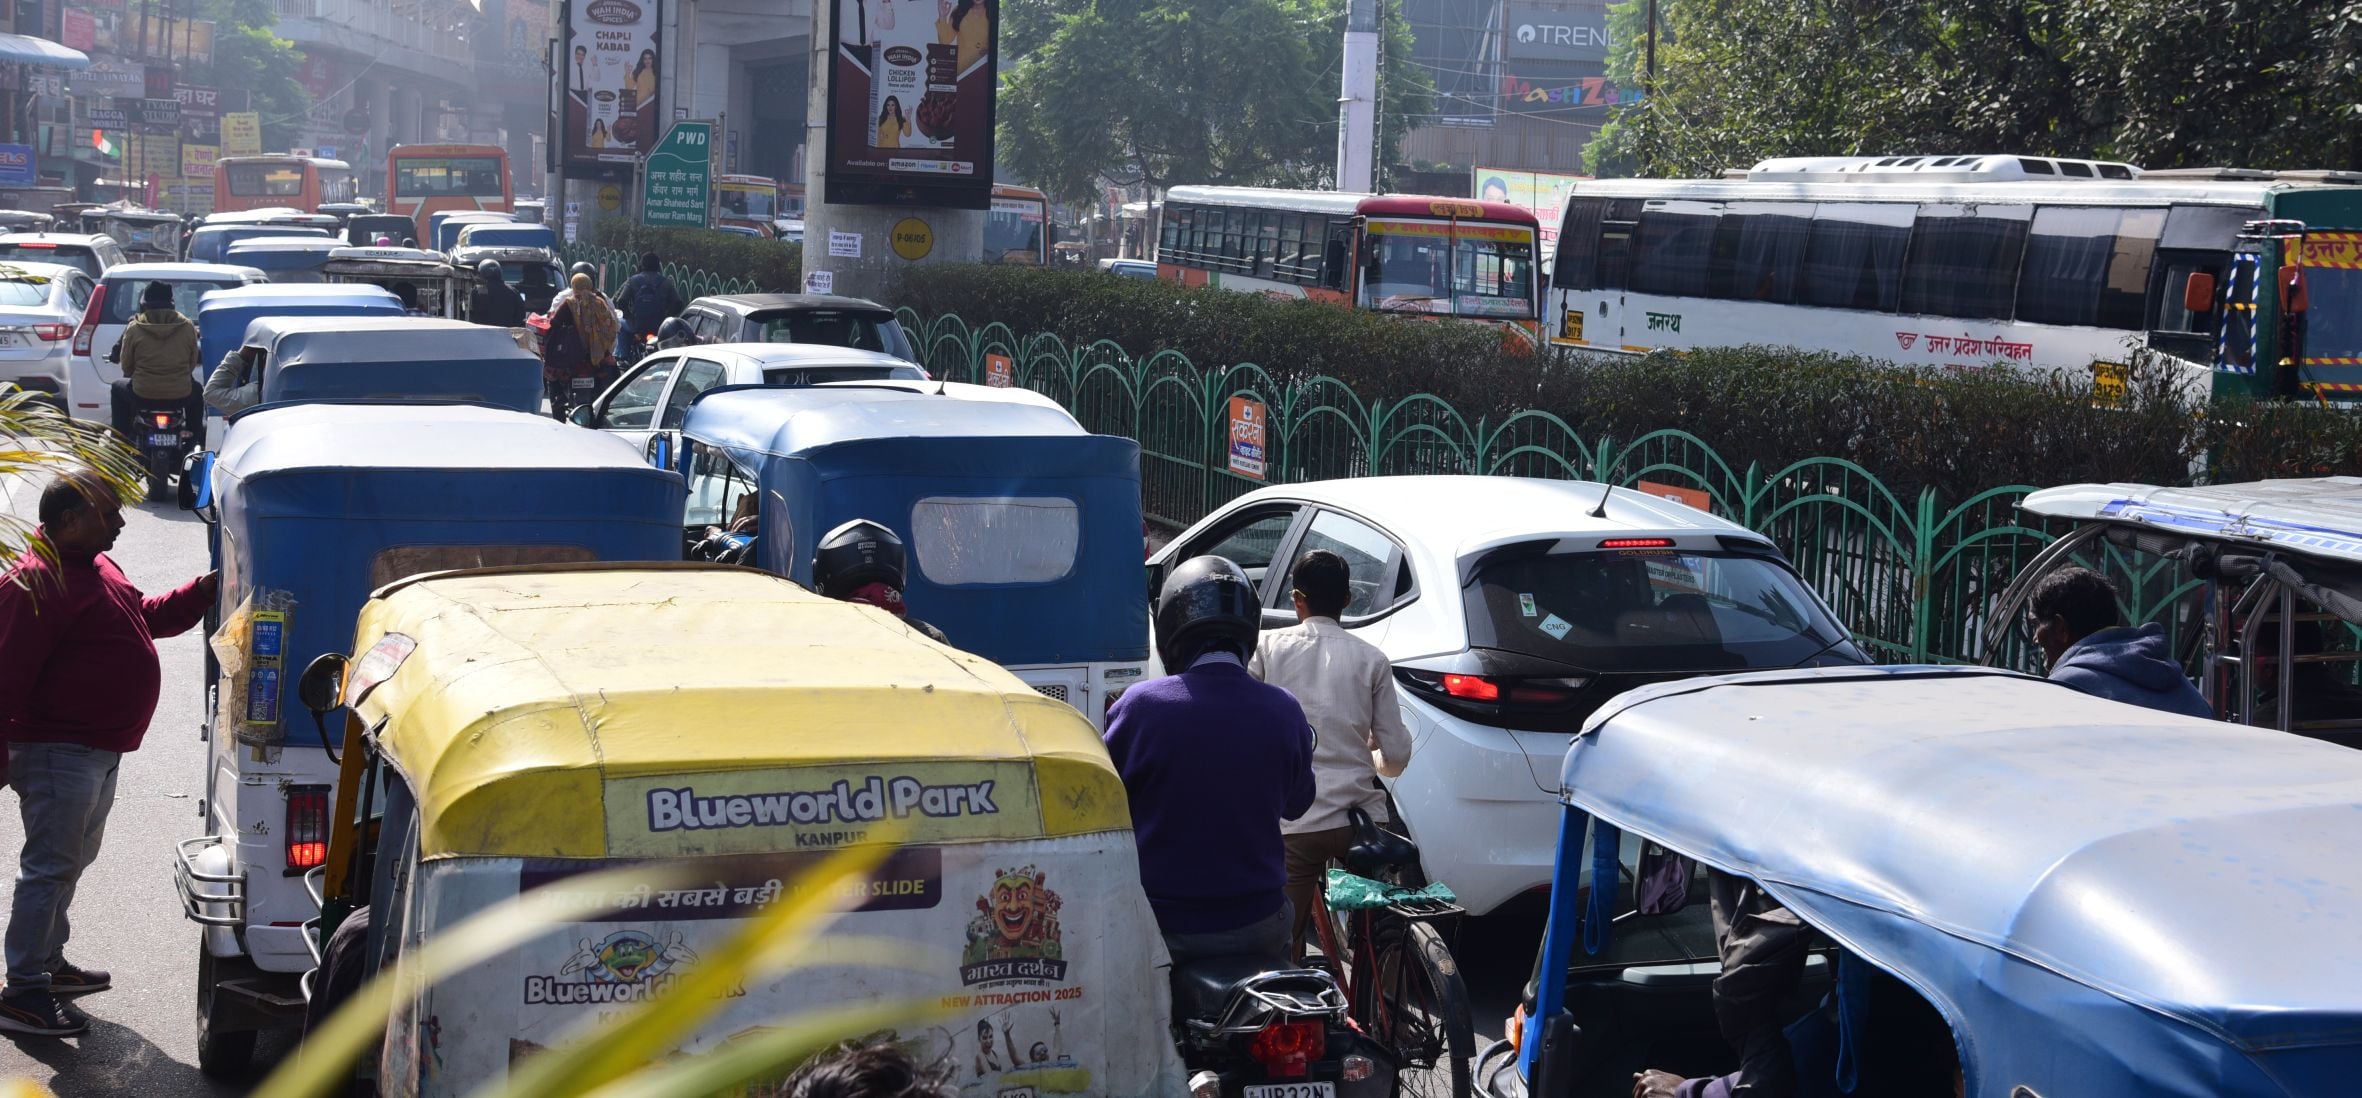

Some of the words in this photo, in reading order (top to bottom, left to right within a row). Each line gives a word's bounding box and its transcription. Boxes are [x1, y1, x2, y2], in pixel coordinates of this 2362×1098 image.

[612, 7, 634, 19] INDIA
[595, 31, 632, 40] CHAPLI
[1538, 25, 1611, 47] TREN
[596, 42, 630, 52] KABAB
[142, 110, 180, 121] STUDIO
[91, 119, 124, 128] MOBILE
[676, 132, 705, 145] PWD
[890, 161, 916, 170] amazon
[650, 171, 667, 180] अमर
[669, 169, 687, 182] शहीद
[671, 186, 683, 196] राम
[686, 184, 699, 197] मार्ग
[646, 198, 663, 206] Amar
[663, 198, 690, 208] Shaheed
[690, 199, 704, 209] Sant
[647, 209, 671, 220] Kanwar
[671, 210, 686, 220] Ram
[686, 211, 703, 223] Marg
[2303, 240, 2350, 261] उत्तर
[1645, 311, 1682, 334] जनरथ
[1924, 335, 1952, 353] उत्तर
[1953, 332, 1983, 357] प्रदेश
[1983, 335, 2033, 361] परिवहन
[1545, 623, 1566, 631] CNG
[647, 776, 885, 832] Blueworld
[888, 775, 999, 819] Park
[795, 829, 868, 846] KANPUR
[616, 884, 651, 910] की
[658, 880, 728, 909] सबसे
[733, 877, 785, 911] बड़ी
[871, 879, 925, 897] SLIDE
[966, 963, 1012, 982] भारत
[1017, 959, 1060, 979] दर्शन
[941, 996, 970, 1008] NEW
[974, 990, 1051, 1007] ATTRACTION
[1054, 987, 1082, 1000] 2025
